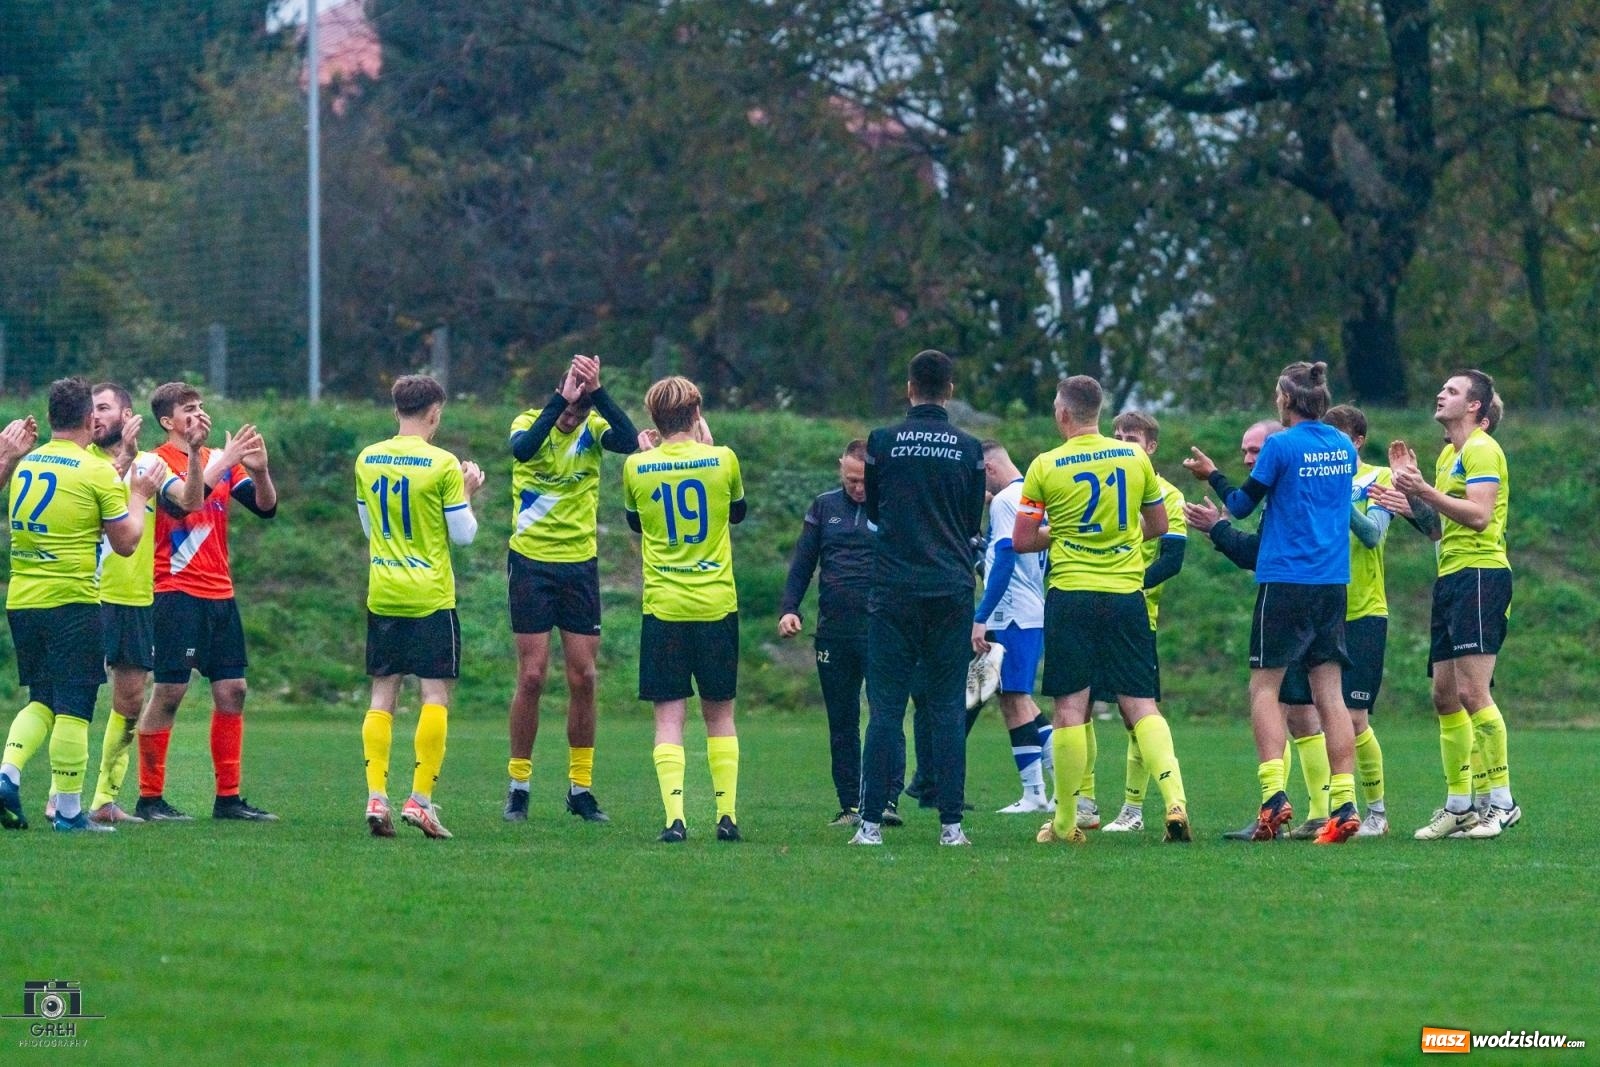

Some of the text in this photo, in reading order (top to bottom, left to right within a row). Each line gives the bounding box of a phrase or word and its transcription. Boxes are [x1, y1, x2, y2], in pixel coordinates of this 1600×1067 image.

[890, 443, 963, 461] CZYŻOWICE
[896, 431, 958, 445] NAPRZÓD
[1303, 448, 1348, 463] NAPRZÓD
[1299, 463, 1352, 477] CZYŻOWICE
[11, 469, 58, 534] 22
[371, 474, 413, 540] 11
[650, 478, 709, 547] 19
[1072, 466, 1128, 534] 21
